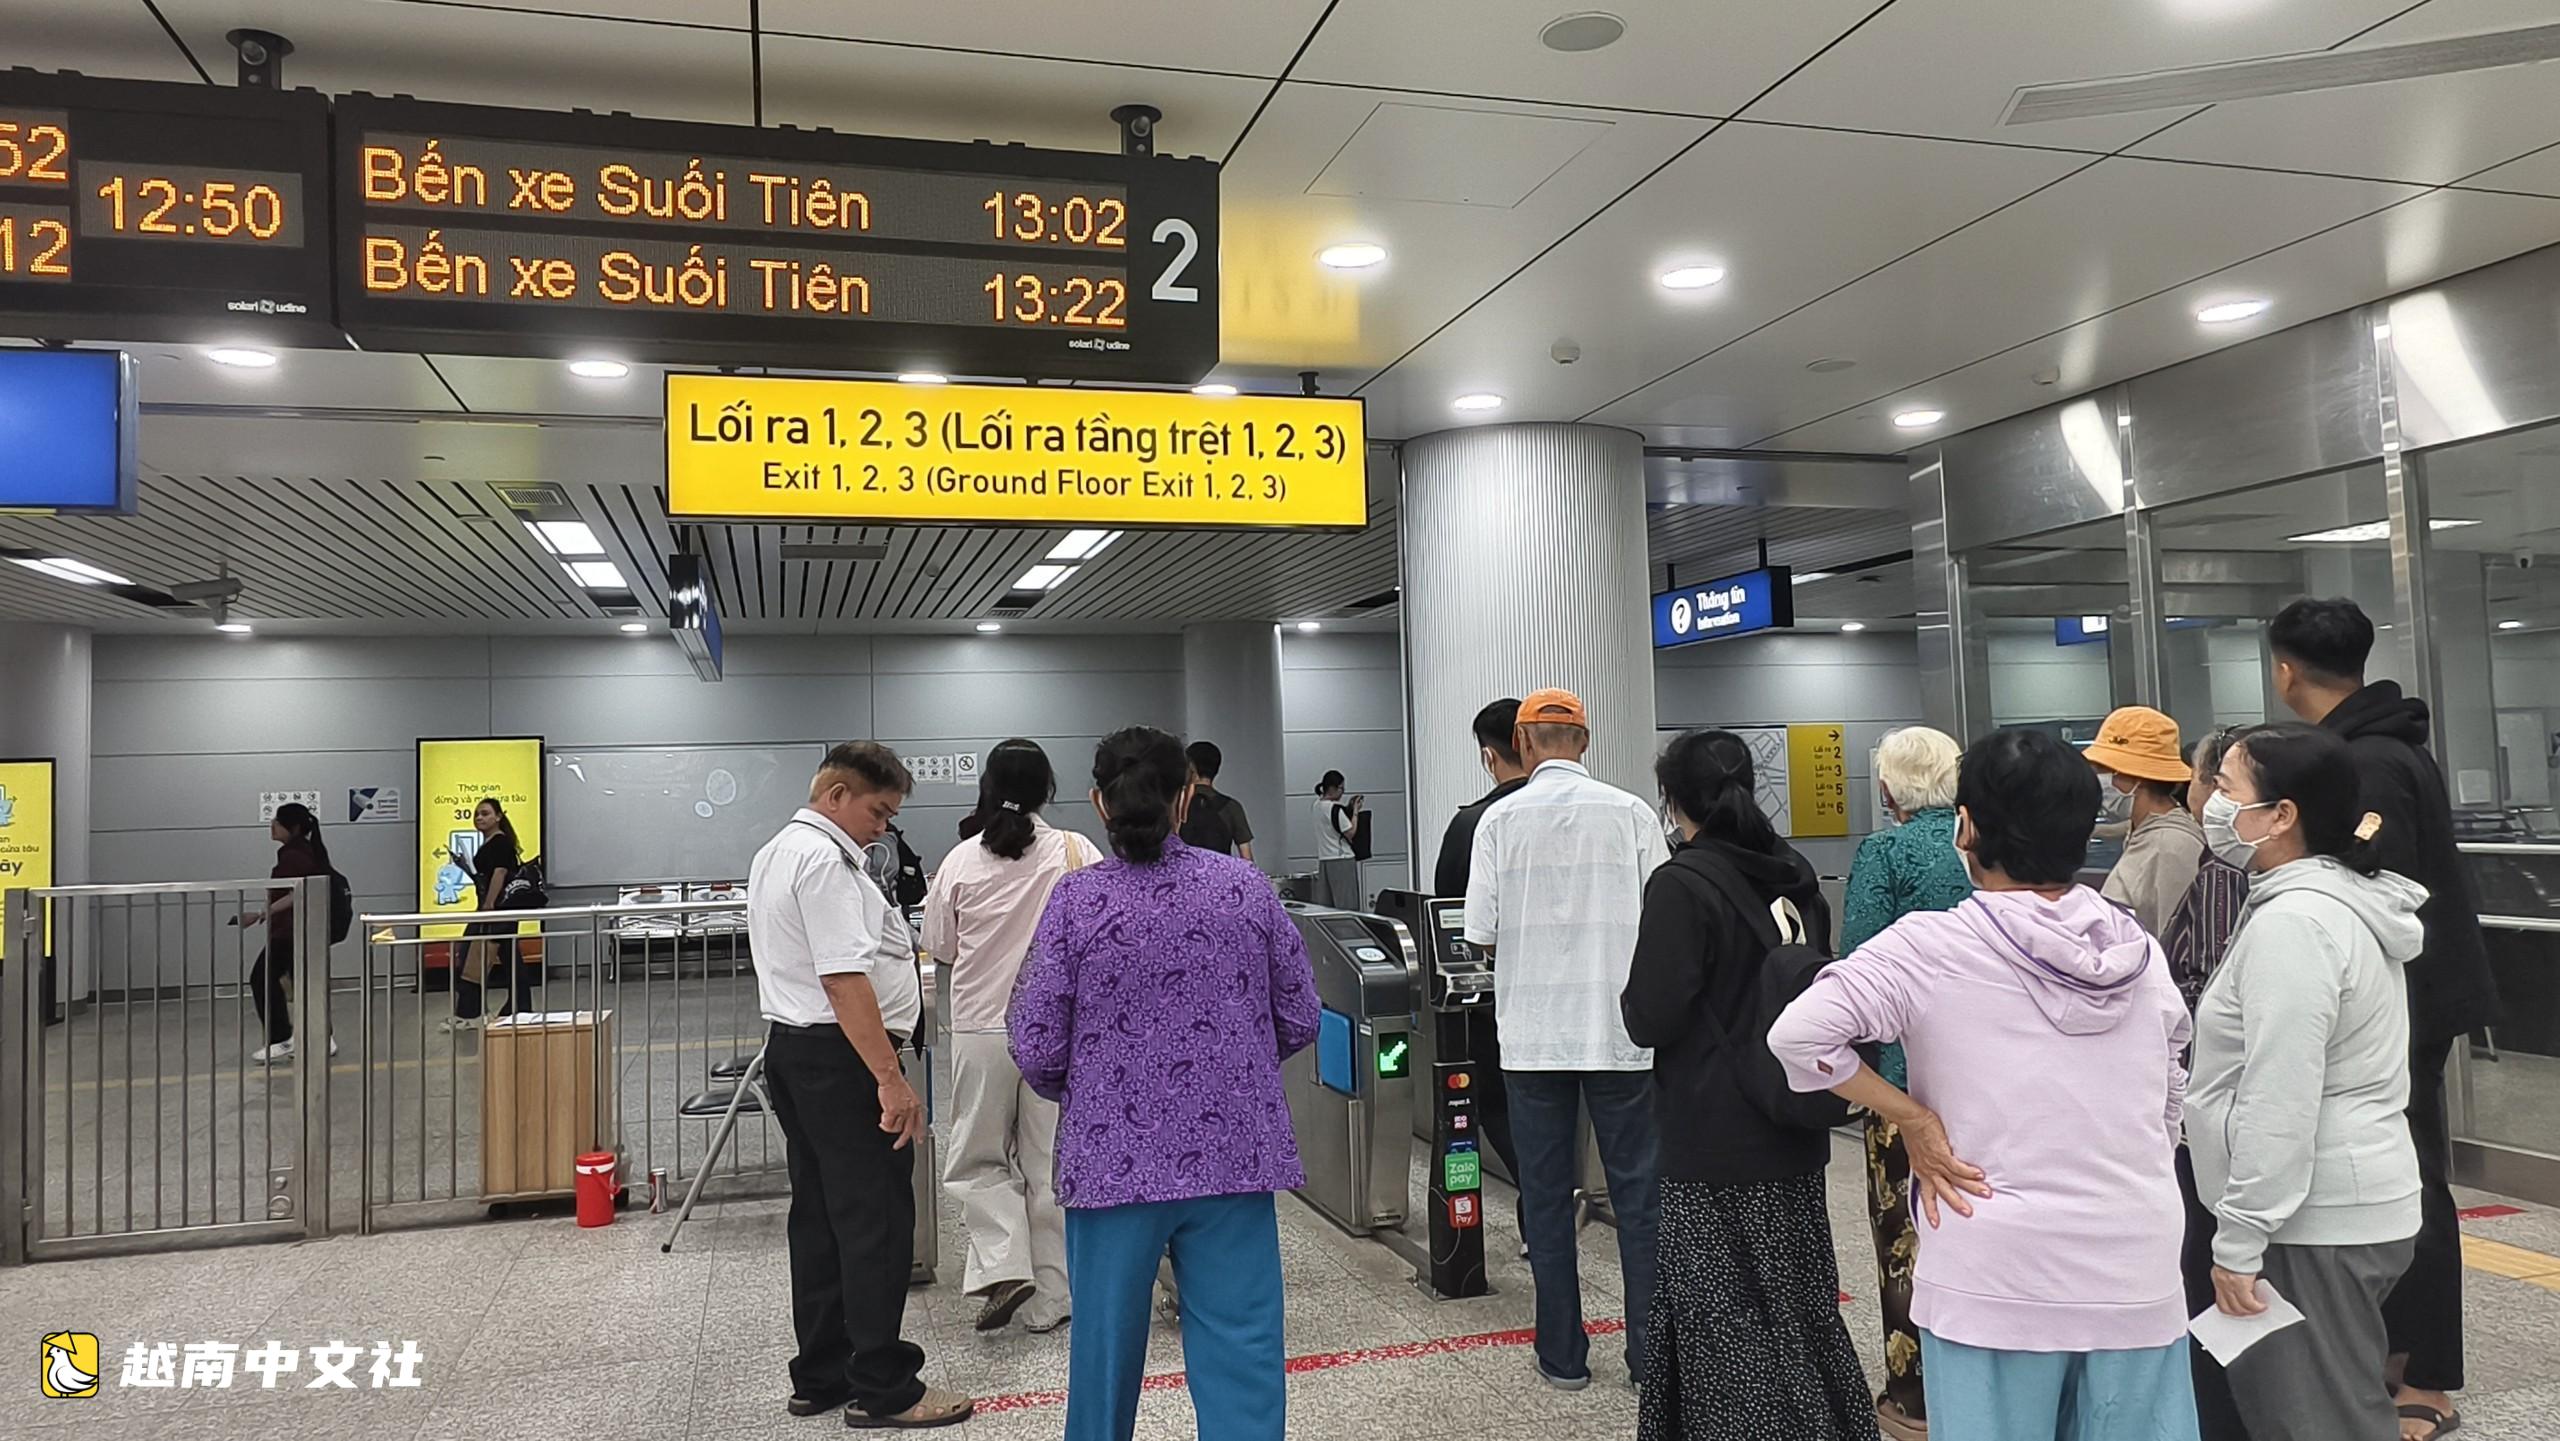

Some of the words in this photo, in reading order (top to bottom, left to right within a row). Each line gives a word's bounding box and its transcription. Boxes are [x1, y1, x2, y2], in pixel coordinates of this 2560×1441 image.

[364, 140, 485, 205] Bến
[508, 169, 575, 211] xe
[597, 158, 725, 221] Suối
[750, 174, 869, 229] Tiên
[984, 191, 1125, 245] 13:02
[99, 177, 280, 238] 12:50
[1152, 218, 1199, 302] 2
[366, 229, 487, 294] Bến
[510, 256, 576, 298] xe
[599, 245, 726, 306] Suối
[750, 259, 869, 313] Tiên
[984, 273, 1125, 325] 13:22
[690, 399, 753, 442] Lối
[767, 415, 809, 444] ra
[823, 407, 847, 449] 1,
[860, 409, 892, 450] 2,
[904, 410, 928, 448] 3
[942, 408, 1012, 453] (Lối
[1026, 424, 1064, 452] ra
[1075, 412, 1157, 463] tầng
[1169, 421, 1231, 465] trệt
[1243, 422, 1265, 460] 1,
[1275, 423, 1304, 461] 2,
[1314, 425, 1346, 464] 3)
[763, 462, 821, 490] Exit
[832, 464, 851, 492] 1,
[863, 465, 887, 493] 2,
[898, 466, 915, 491] 3
[927, 466, 1046, 497] (Ground
[1058, 469, 1132, 496] Floor
[1143, 471, 1194, 498] Exit
[1204, 473, 1221, 500] 1,
[1231, 474, 1253, 500] 2,
[1262, 474, 1286, 503] 3)
[1834, 746, 1842, 759] 2
[1834, 764, 1842, 777] 3
[1835, 783, 1843, 796] 5
[454, 809, 472, 820] 30
[1836, 801, 1844, 815] 6
[1448, 1162, 1475, 1174] Zalo
[1450, 1174, 1473, 1187] pay
[1455, 1214, 1473, 1225] Pay
